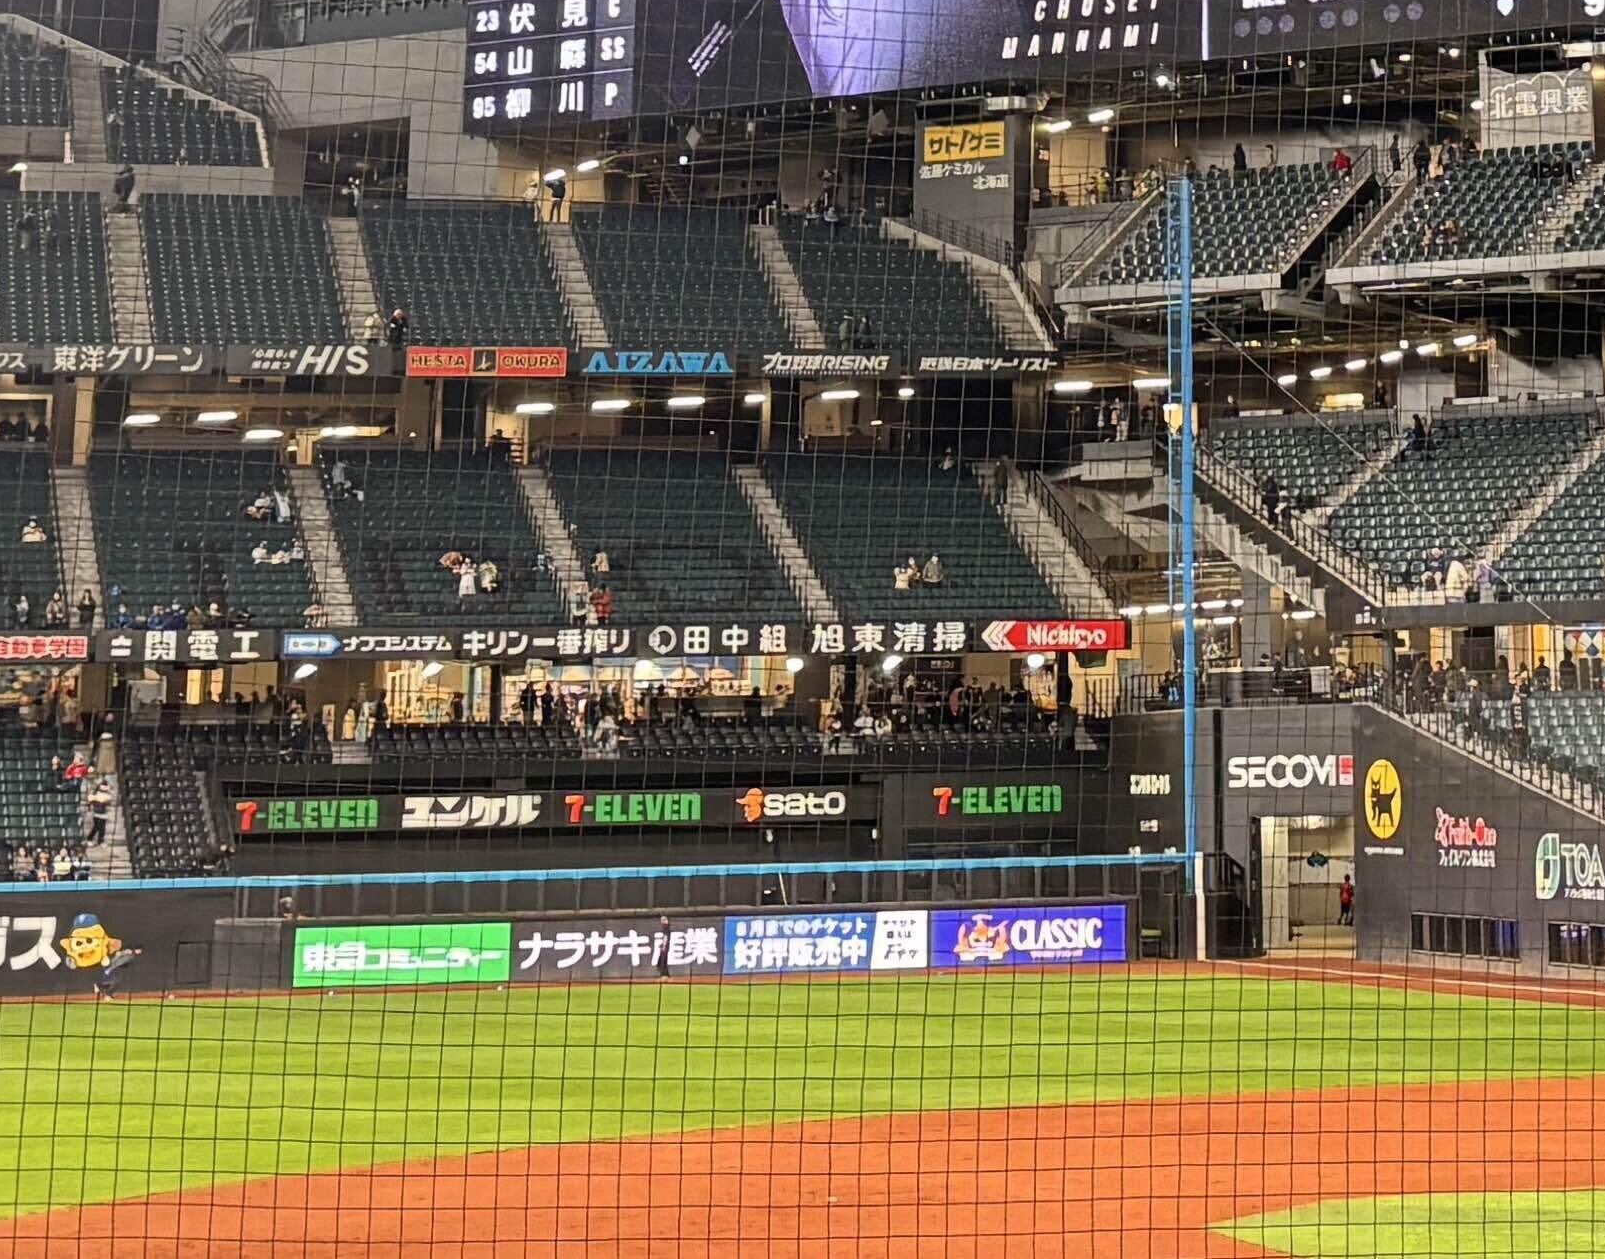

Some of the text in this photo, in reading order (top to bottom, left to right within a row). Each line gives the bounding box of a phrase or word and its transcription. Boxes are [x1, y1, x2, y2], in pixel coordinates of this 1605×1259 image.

[1001, 22, 1159, 59] MANNAMI
[1488, 87, 1590, 118] 北電興業
[52, 345, 204, 374] 東洋グリーン
[296, 345, 369, 375] HIS
[411, 354, 560, 368] HESTA OKURA
[583, 351, 734, 374] AIZAWA
[144, 630, 260, 660] 関電工
[463, 628, 631, 657] キリン一番搾り
[683, 624, 786, 654] 田中組
[811, 622, 966, 654] 旭東清掃
[1229, 756, 1337, 789] SECOM
[235, 798, 378, 831] 7-ELEVEN
[401, 795, 542, 828] ユンケル
[565, 791, 702, 824] 7-ELEVEN
[762, 791, 846, 817] sato
[932, 784, 1062, 817] 7-ELEVEN
[518, 927, 719, 971] ナラサキ産業
[1011, 917, 1102, 953] CLASSIC
[302, 940, 504, 972] 東急コミュニティー
[734, 935, 868, 969] 好評販売中
